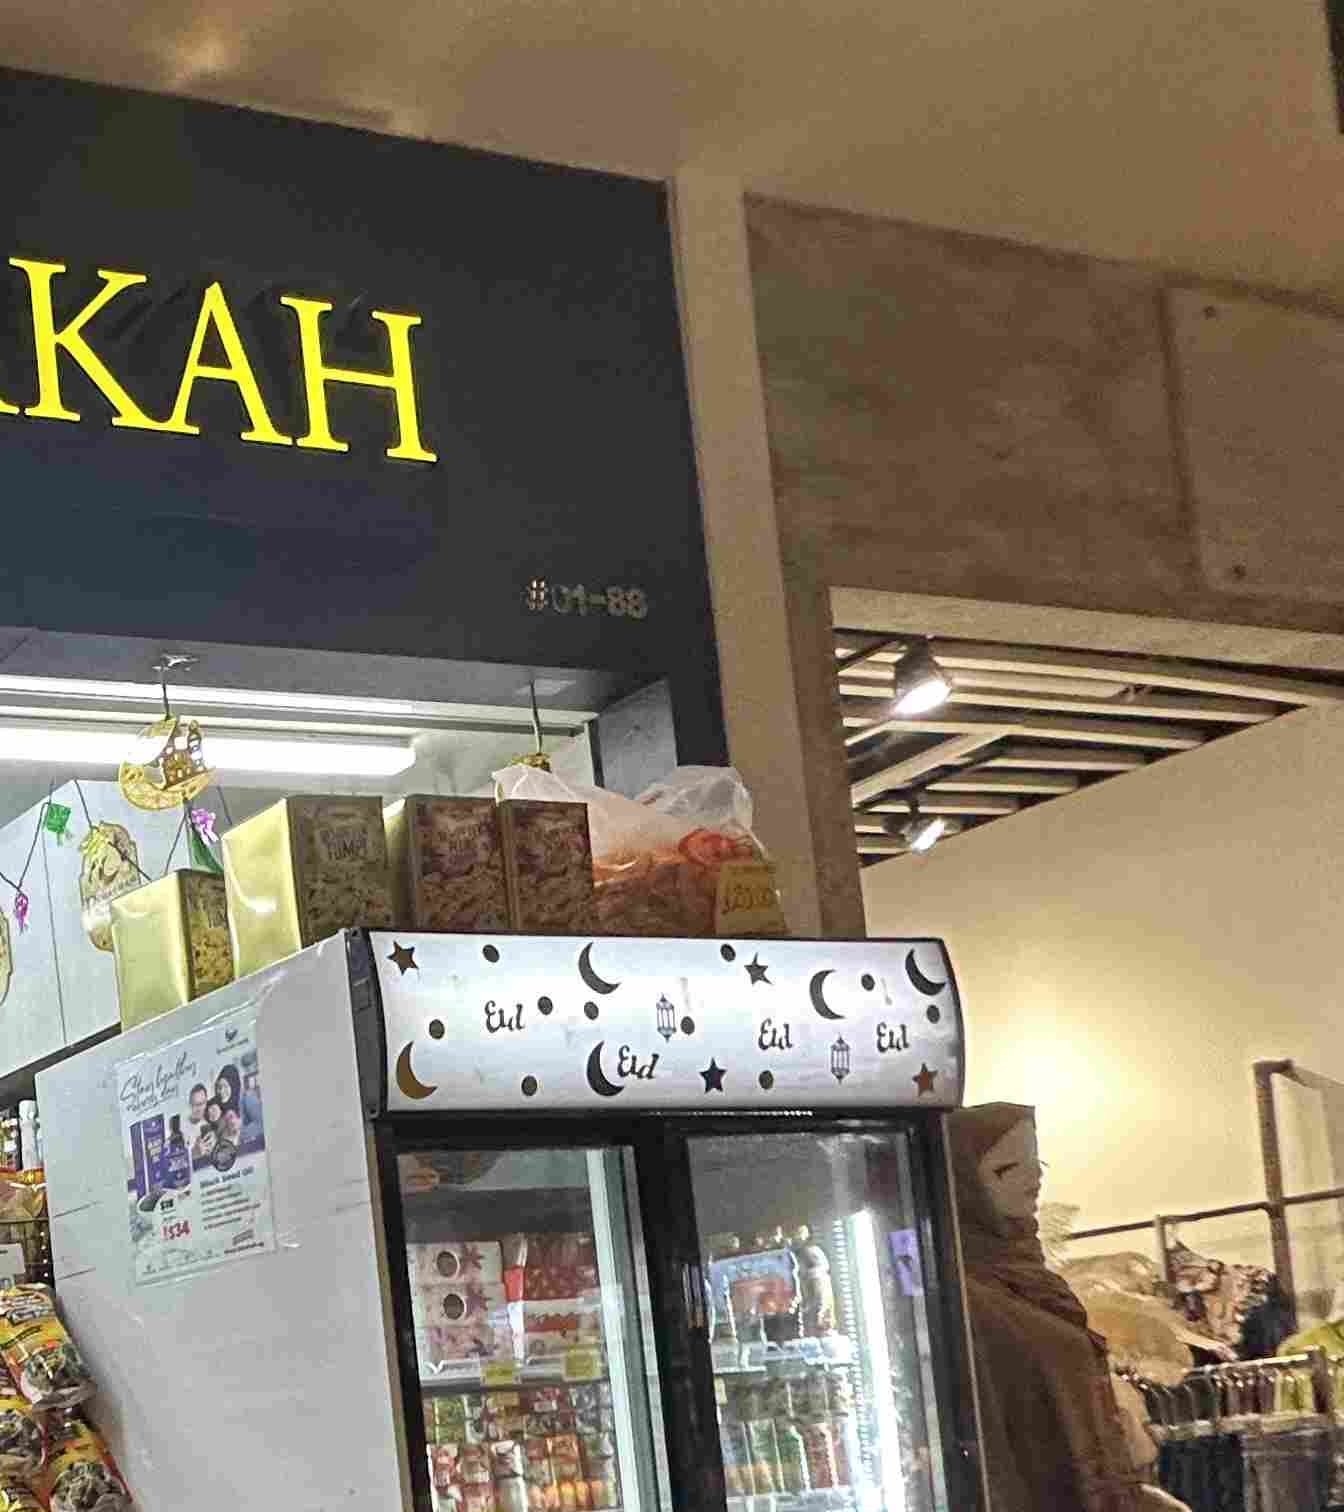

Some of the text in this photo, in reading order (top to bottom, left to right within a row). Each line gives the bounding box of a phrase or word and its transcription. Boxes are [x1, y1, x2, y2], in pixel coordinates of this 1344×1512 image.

[483, 1000, 525, 1034] Eid
[757, 1017, 793, 1051] Eid
[875, 1021, 910, 1053] Eid
[616, 1044, 660, 1080] Eid
